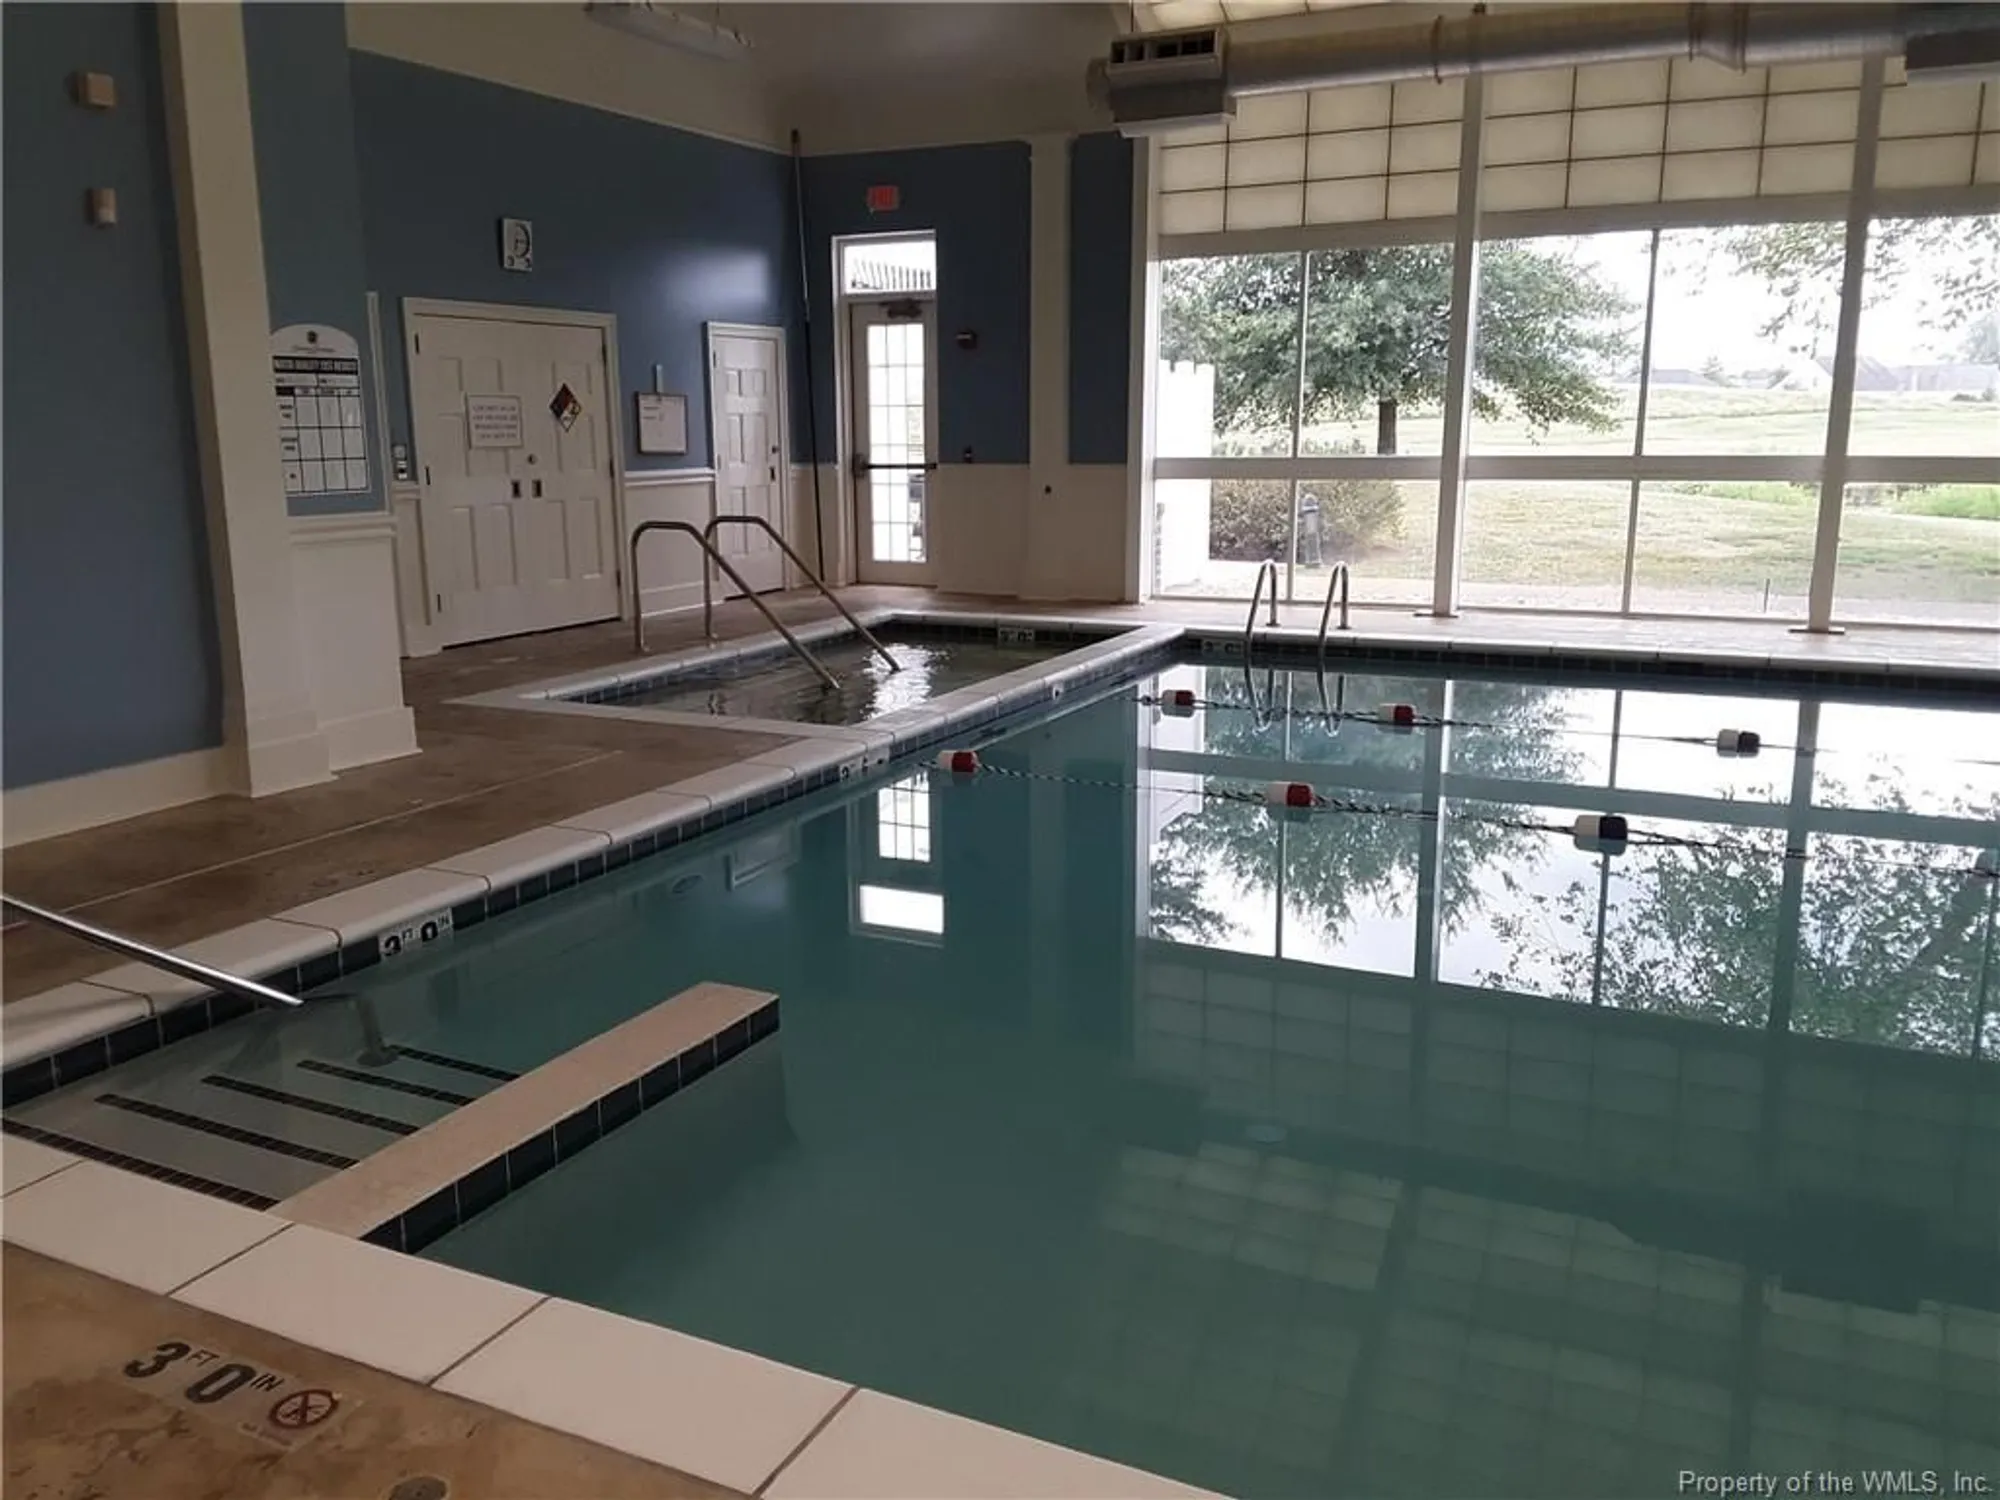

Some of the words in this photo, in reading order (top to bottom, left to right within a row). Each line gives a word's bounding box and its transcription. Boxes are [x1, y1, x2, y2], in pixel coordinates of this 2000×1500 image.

[123, 1341, 191, 1378] 3
[187, 1348, 220, 1366] FT
[185, 1363, 257, 1404] 0
[250, 1372, 286, 1392] IN
